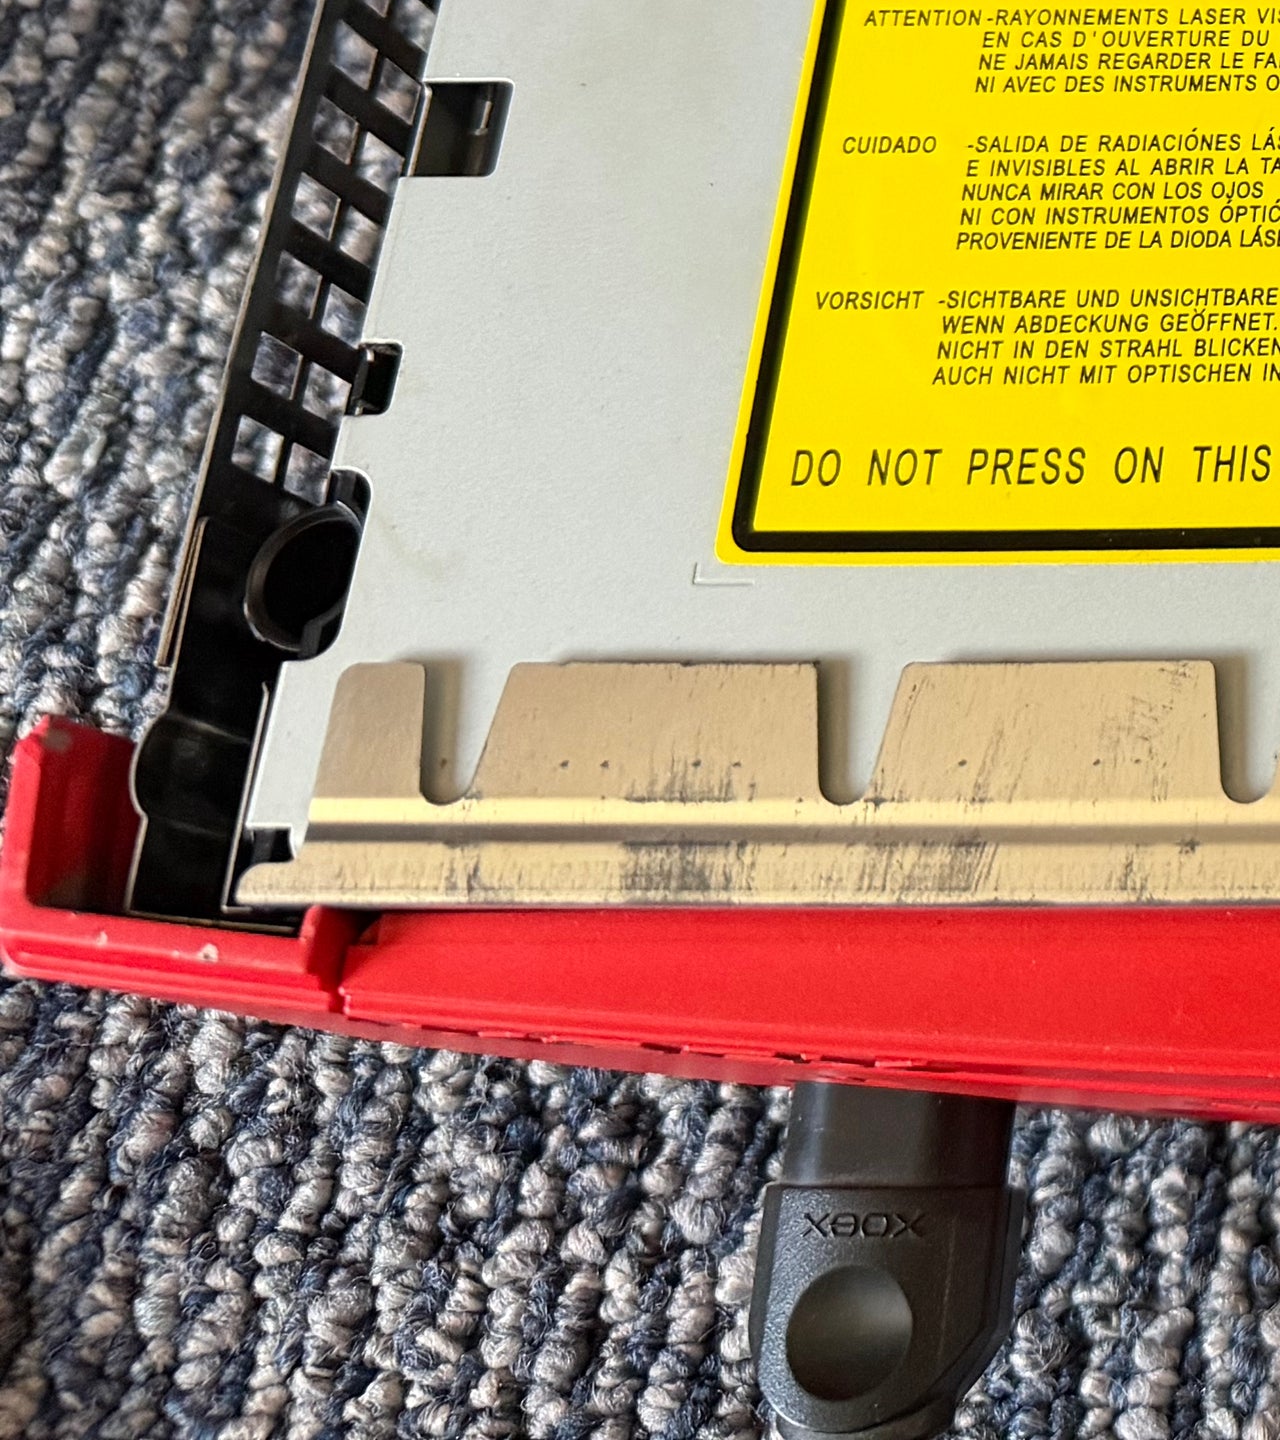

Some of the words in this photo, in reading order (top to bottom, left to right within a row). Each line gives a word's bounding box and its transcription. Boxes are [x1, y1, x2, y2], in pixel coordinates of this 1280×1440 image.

[864, 10, 981, 26] ATTENTION
[987, 9, 1168, 25] -RAYONNEMENTS
[1180, 8, 1245, 24] LASER
[979, 54, 1006, 70] NE
[1015, 53, 1088, 70] JAMAIS
[1098, 53, 1210, 69] REGARDER
[1221, 52, 1244, 68] LE
[843, 136, 936, 154] CUIDADO
[968, 136, 1048, 153] -SALIDA
[1060, 135, 1087, 152] DE
[1099, 128, 1240, 152] RADIACIÓNES
[967, 160, 979, 177] E
[991, 159, 1105, 176] INVISIBLES
[1115, 159, 1139, 175] AL
[1151, 158, 1214, 175] ABRIR
[1225, 158, 1248, 174] LA
[961, 208, 981, 225] NI
[992, 208, 1035, 225] CON
[1046, 206, 1209, 225] INSTRUMENTOS
[957, 231, 1097, 250] PROVENIENTE
[1105, 231, 1131, 248] DE
[1139, 231, 1162, 248] LA
[1171, 230, 1231, 248] DIODA
[817, 291, 924, 309] VORSICHT
[939, 290, 1066, 308] -SICHTBARE
[1077, 290, 1119, 308] UND
[1131, 288, 1278, 307] UNSICHTBARE
[943, 315, 1004, 334] WENN
[1015, 314, 1148, 333] ABDECKUNG
[1161, 309, 1277, 332] GEÖFFNET.
[932, 366, 993, 385] AUCH
[1004, 366, 1070, 384] NICHT
[1080, 365, 1117, 383] MIT
[1128, 363, 1251, 383] OPTISCHEN
[791, 449, 841, 486] DO
[868, 449, 942, 486] NOT
[967, 447, 1085, 484] PRESS
[1115, 447, 1163, 484] ON
[1194, 445, 1271, 482] THIS
[801, 1212, 924, 1238] XBOX
